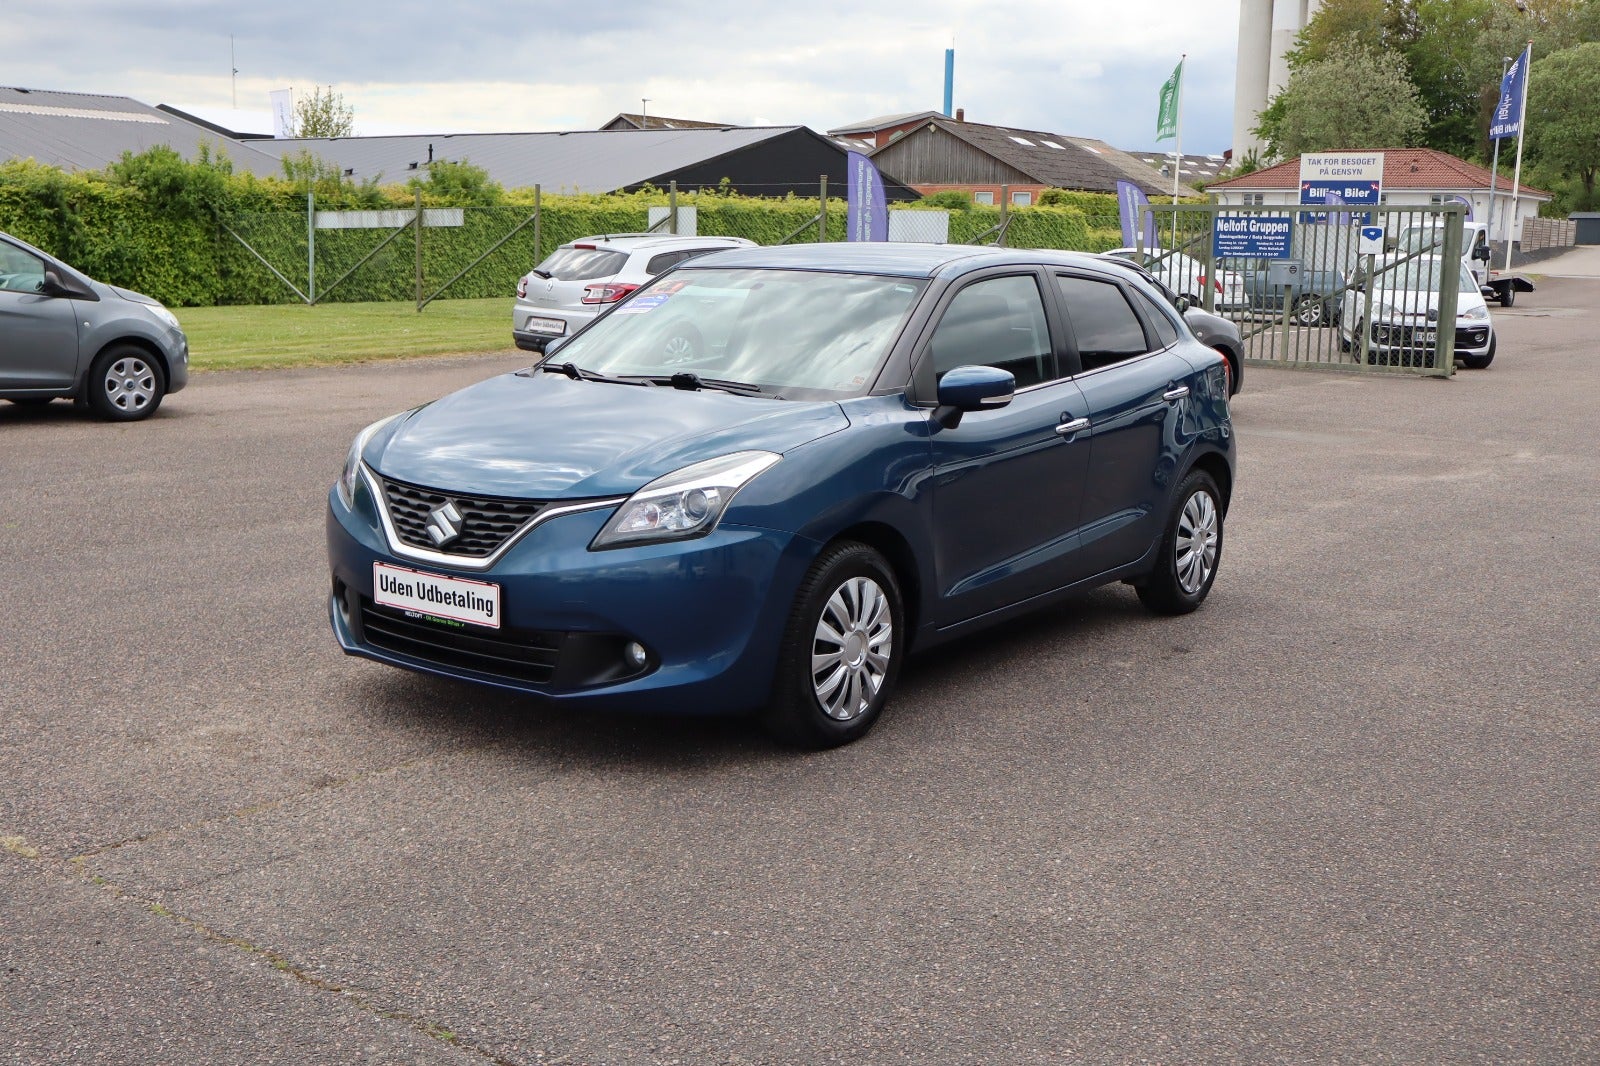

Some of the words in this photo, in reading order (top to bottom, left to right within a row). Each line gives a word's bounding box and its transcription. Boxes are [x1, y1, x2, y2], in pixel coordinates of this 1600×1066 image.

[1308, 158, 1322, 166] TAK
[1323, 158, 1339, 166] FOR
[1341, 157, 1376, 166] BESØGET
[1319, 167, 1329, 176] PÅ
[1332, 168, 1363, 176] GENSYN
[1309, 188, 1341, 198] Bille
[1344, 187, 1371, 198] Biler
[1217, 219, 1247, 232] Neltoft
[1249, 219, 1289, 235] Gruppen
[380, 574, 413, 597] Uden
[417, 581, 494, 618] Udbetaling
